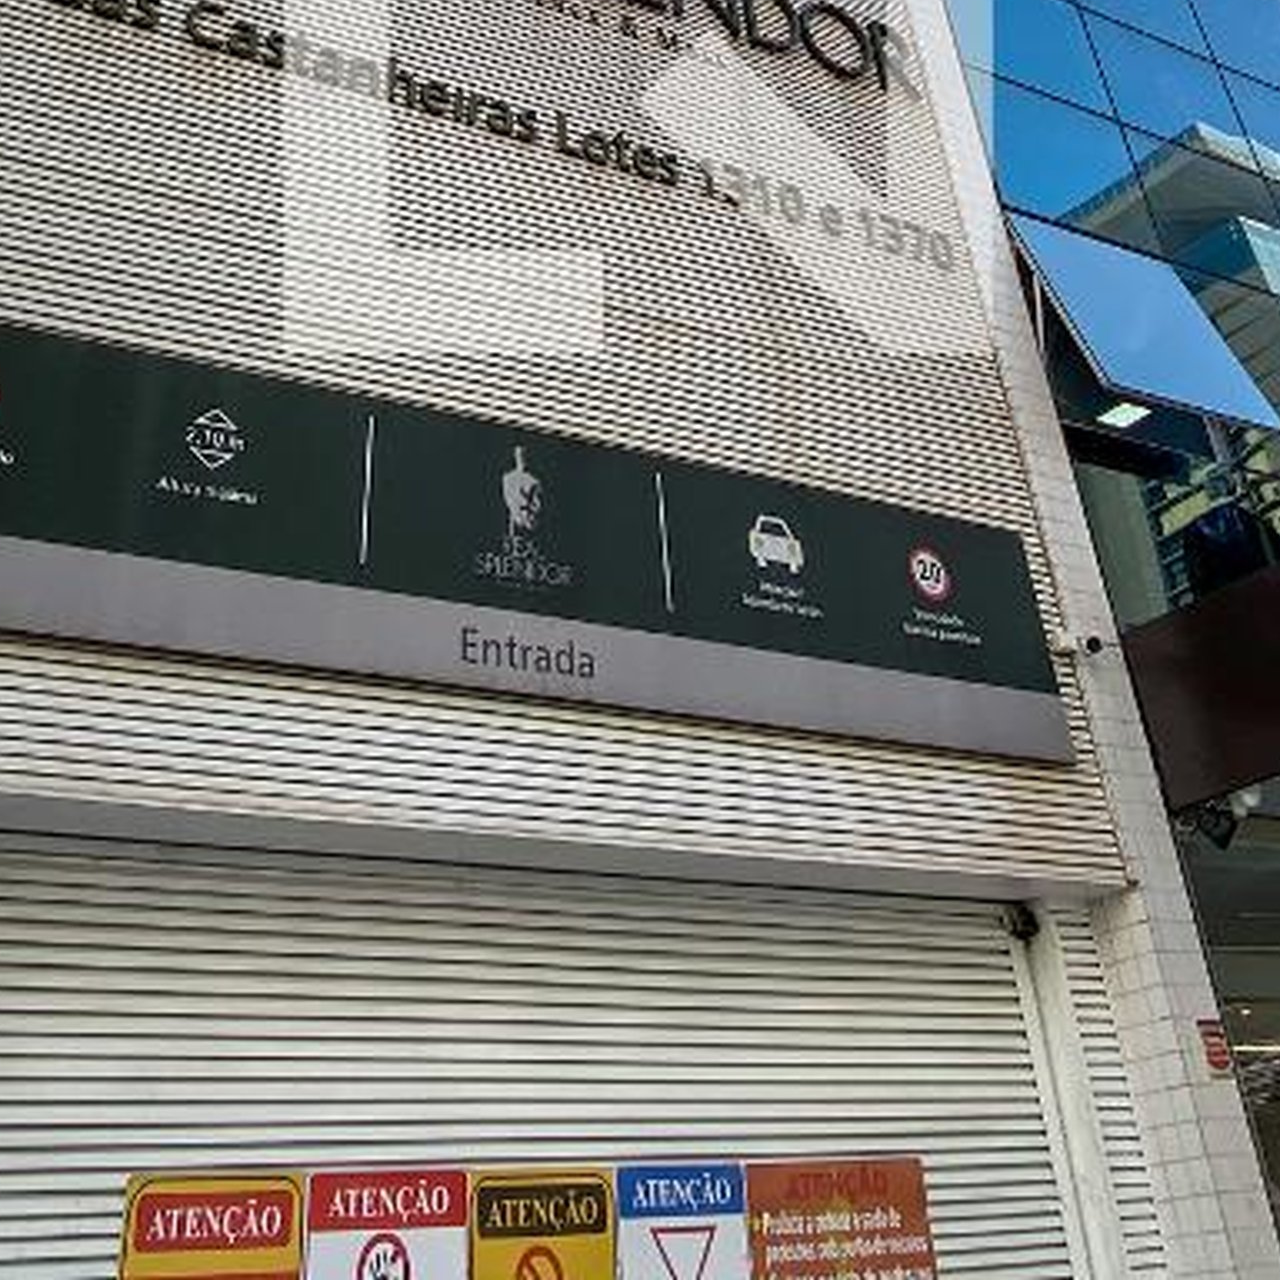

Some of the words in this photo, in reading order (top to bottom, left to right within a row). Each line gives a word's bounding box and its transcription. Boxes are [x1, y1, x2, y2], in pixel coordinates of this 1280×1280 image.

[186, 0, 539, 142] Castanheiras
[556, 110, 680, 186] Lotes
[461, 626, 596, 678] Entrada
[329, 1179, 450, 1222] ATENÇÃO
[486, 1190, 598, 1231] ATENÇÃO
[632, 1172, 732, 1211] ATENÇÃO
[146, 1199, 282, 1244] ATENÇÃO
